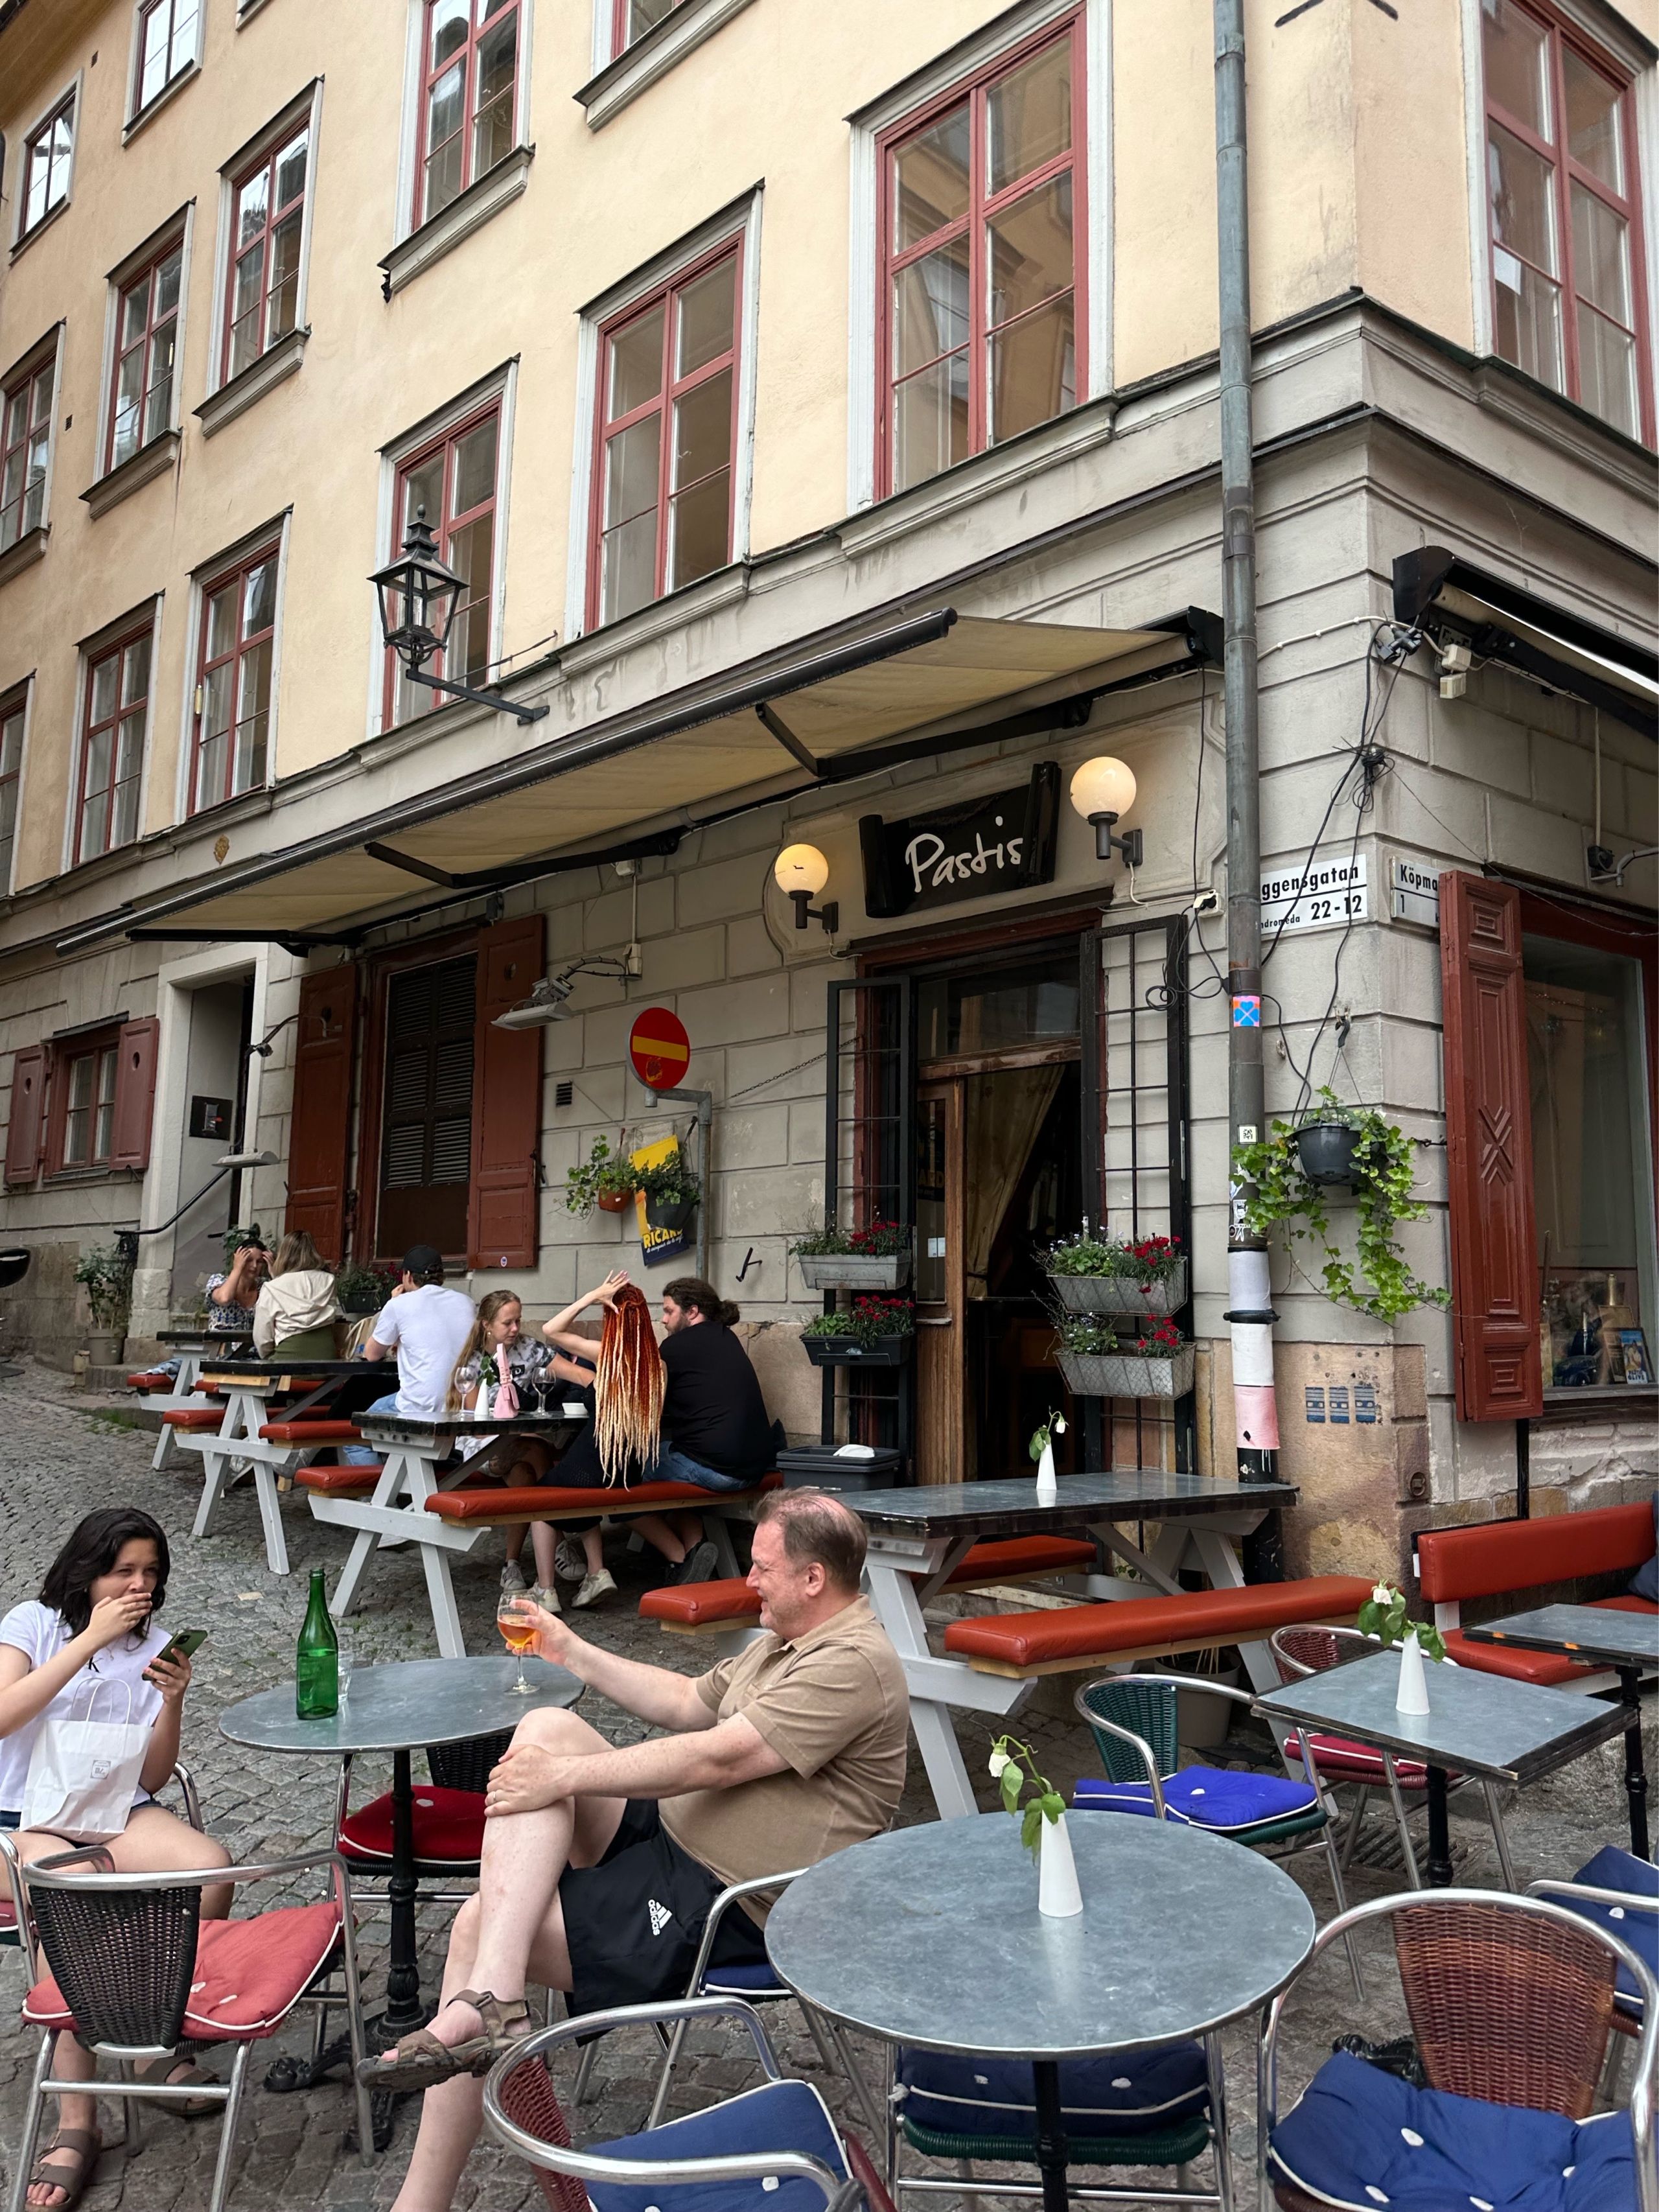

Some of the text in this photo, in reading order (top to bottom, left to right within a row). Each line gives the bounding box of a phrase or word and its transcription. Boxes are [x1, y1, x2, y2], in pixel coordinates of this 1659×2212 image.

[905, 815, 1024, 893] Pastis
[1400, 864, 1438, 892] Köpma
[1400, 894, 1405, 913] 1
[648, 1899, 660, 1936] adidas
